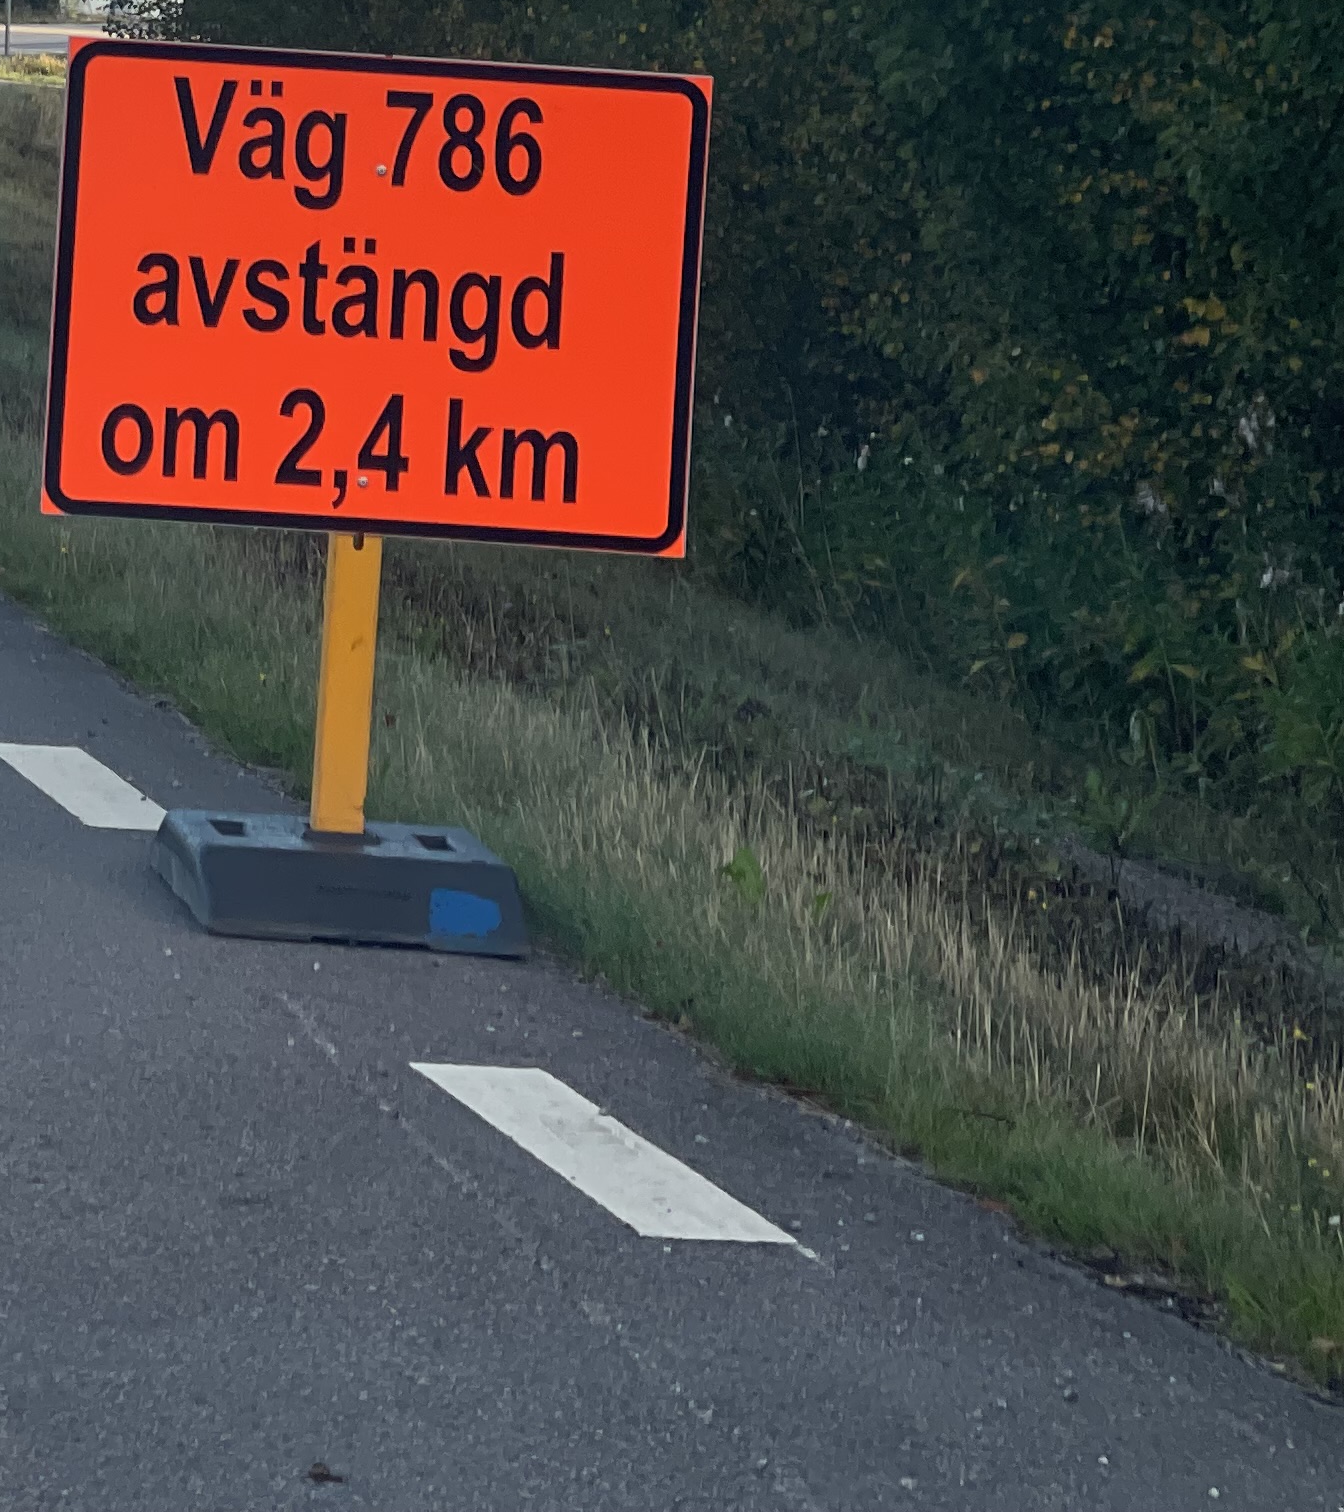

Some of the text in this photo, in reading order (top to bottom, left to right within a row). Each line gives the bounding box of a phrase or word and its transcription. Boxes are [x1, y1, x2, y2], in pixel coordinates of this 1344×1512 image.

[173, 76, 545, 211] Väg 786
[132, 236, 565, 373] avstängd
[101, 388, 579, 510] om 2,4 km
